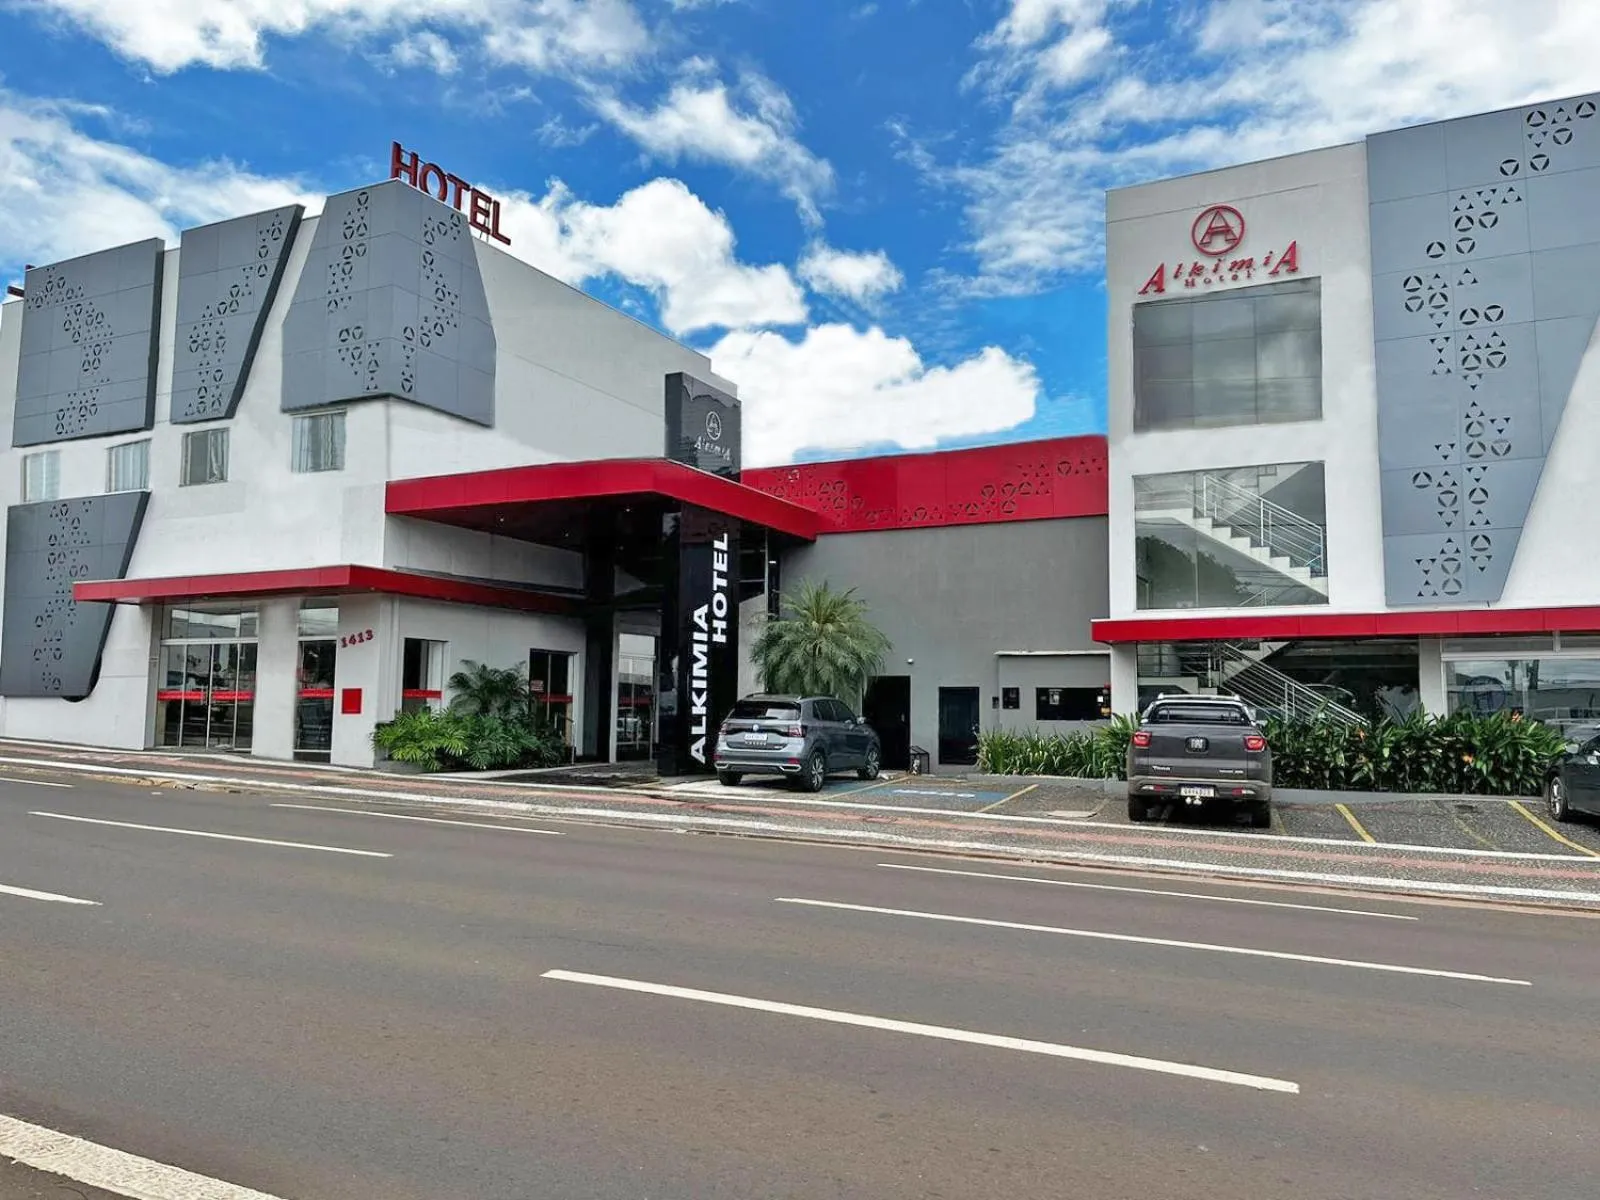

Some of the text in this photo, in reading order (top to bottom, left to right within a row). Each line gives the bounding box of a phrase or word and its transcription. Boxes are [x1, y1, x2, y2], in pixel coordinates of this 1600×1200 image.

[391, 141, 511, 246] HOTEL
[341, 629, 373, 648] 1413
[712, 532, 728, 643] HOTEL
[690, 603, 709, 763] ALKIMIA
